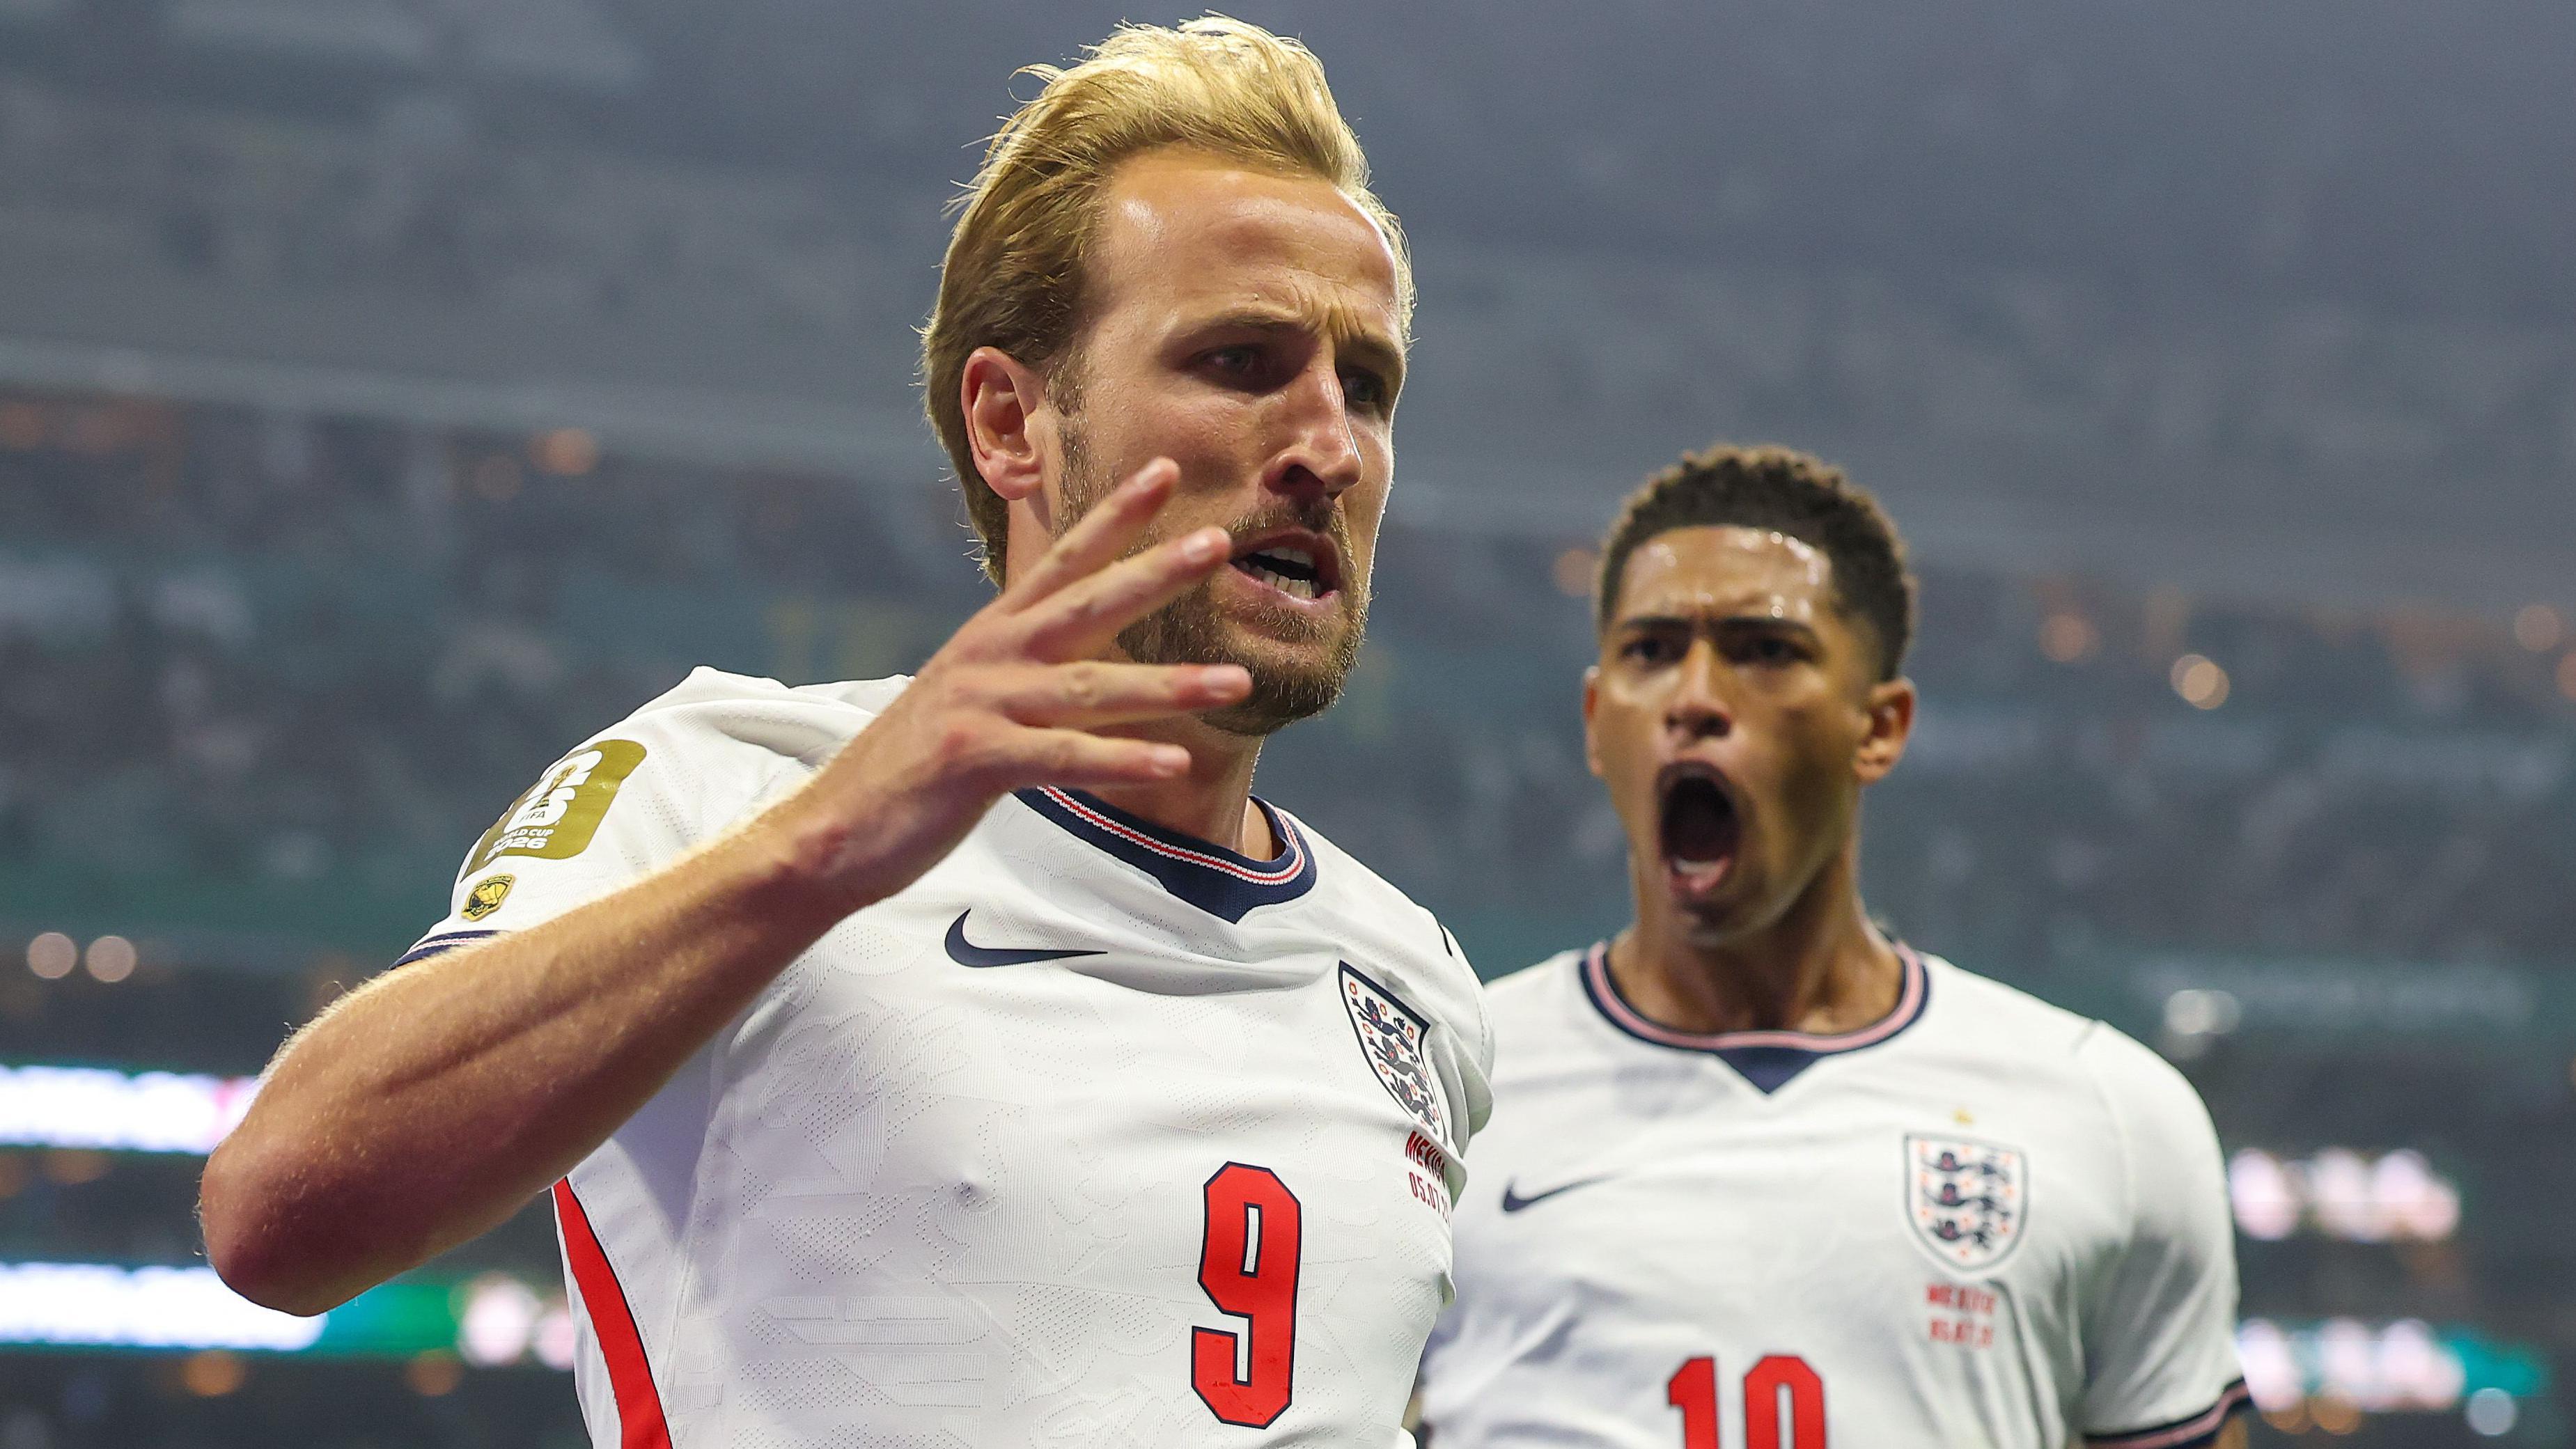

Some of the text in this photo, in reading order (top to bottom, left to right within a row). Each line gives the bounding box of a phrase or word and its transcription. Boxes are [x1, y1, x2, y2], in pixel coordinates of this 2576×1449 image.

[529, 829, 554, 837] CUP
[1409, 1171, 1451, 1228] 05.07.2
[1192, 1161, 1302, 1430] 9
[1667, 1355, 1826, 1449] 10
